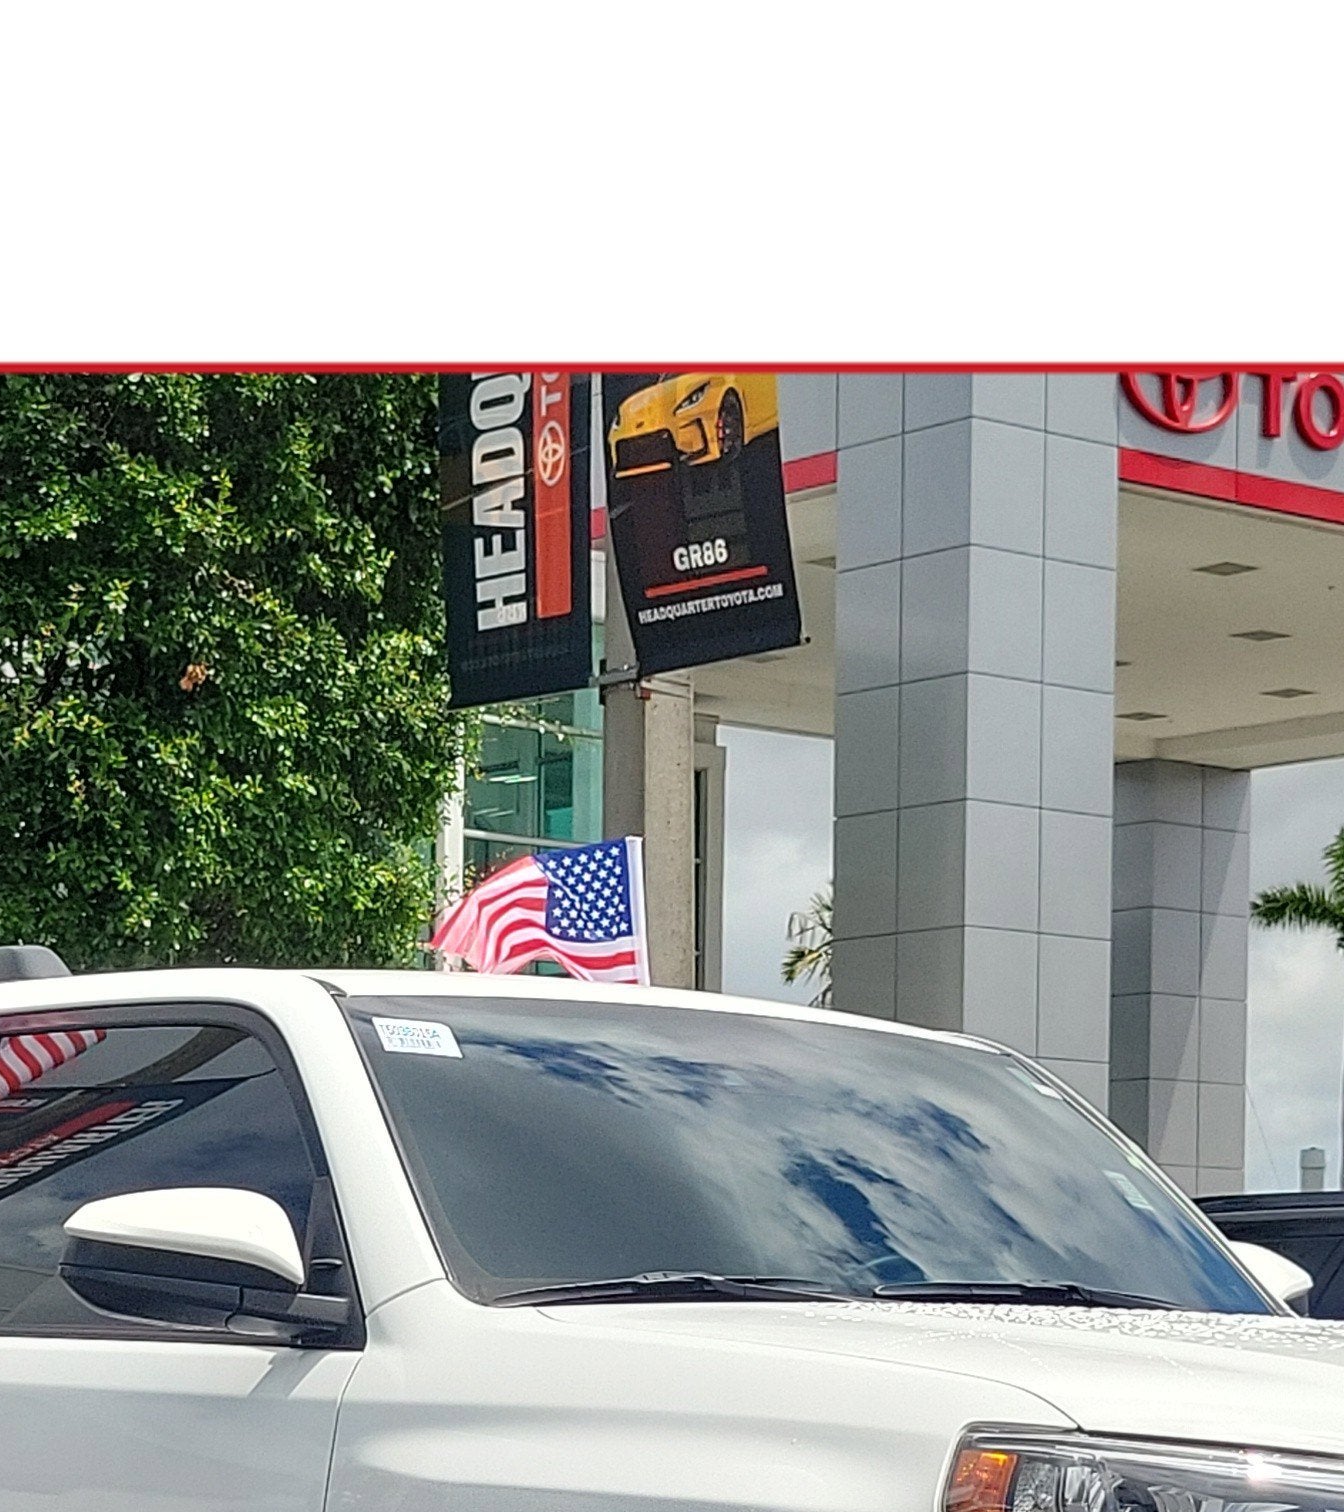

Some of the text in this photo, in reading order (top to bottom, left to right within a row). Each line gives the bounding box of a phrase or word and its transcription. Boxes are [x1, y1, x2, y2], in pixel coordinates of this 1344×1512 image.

[470, 372, 532, 631] HEADQ
[673, 538, 729, 572] GR86
[638, 583, 784, 624] HEADQUARTERTOYOTA.COM
